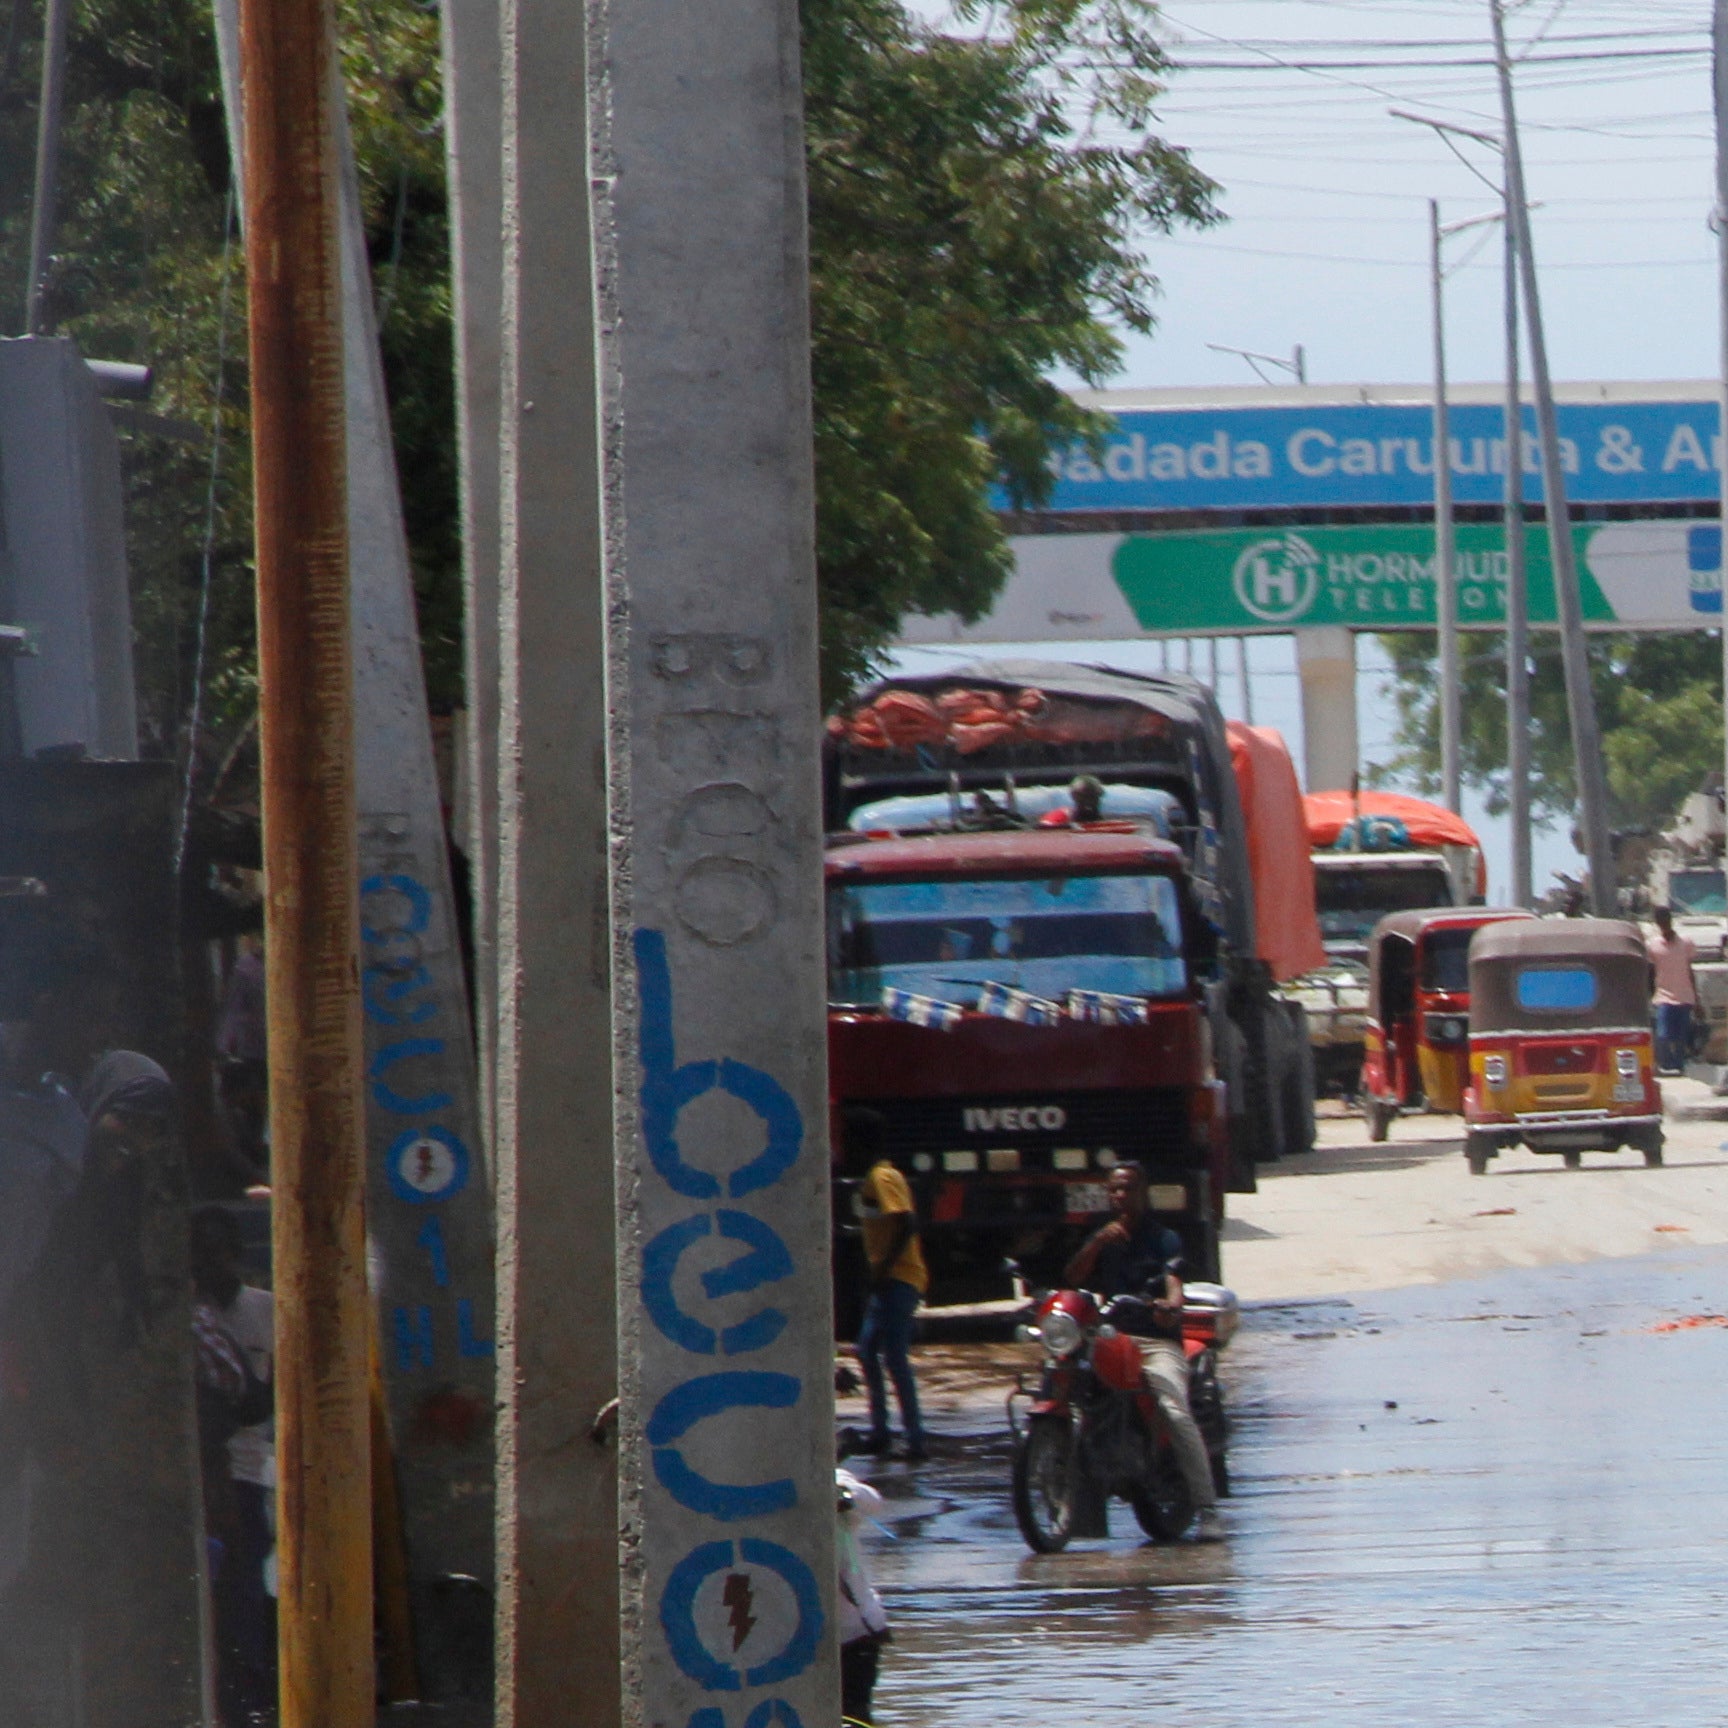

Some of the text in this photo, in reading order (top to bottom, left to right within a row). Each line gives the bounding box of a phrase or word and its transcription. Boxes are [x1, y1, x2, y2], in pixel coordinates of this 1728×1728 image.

[1597, 425, 1643, 474] &
[1328, 586, 1513, 612] TELEO
[963, 1106, 1066, 1131] IVECO
[632, 927, 826, 1692] beco
